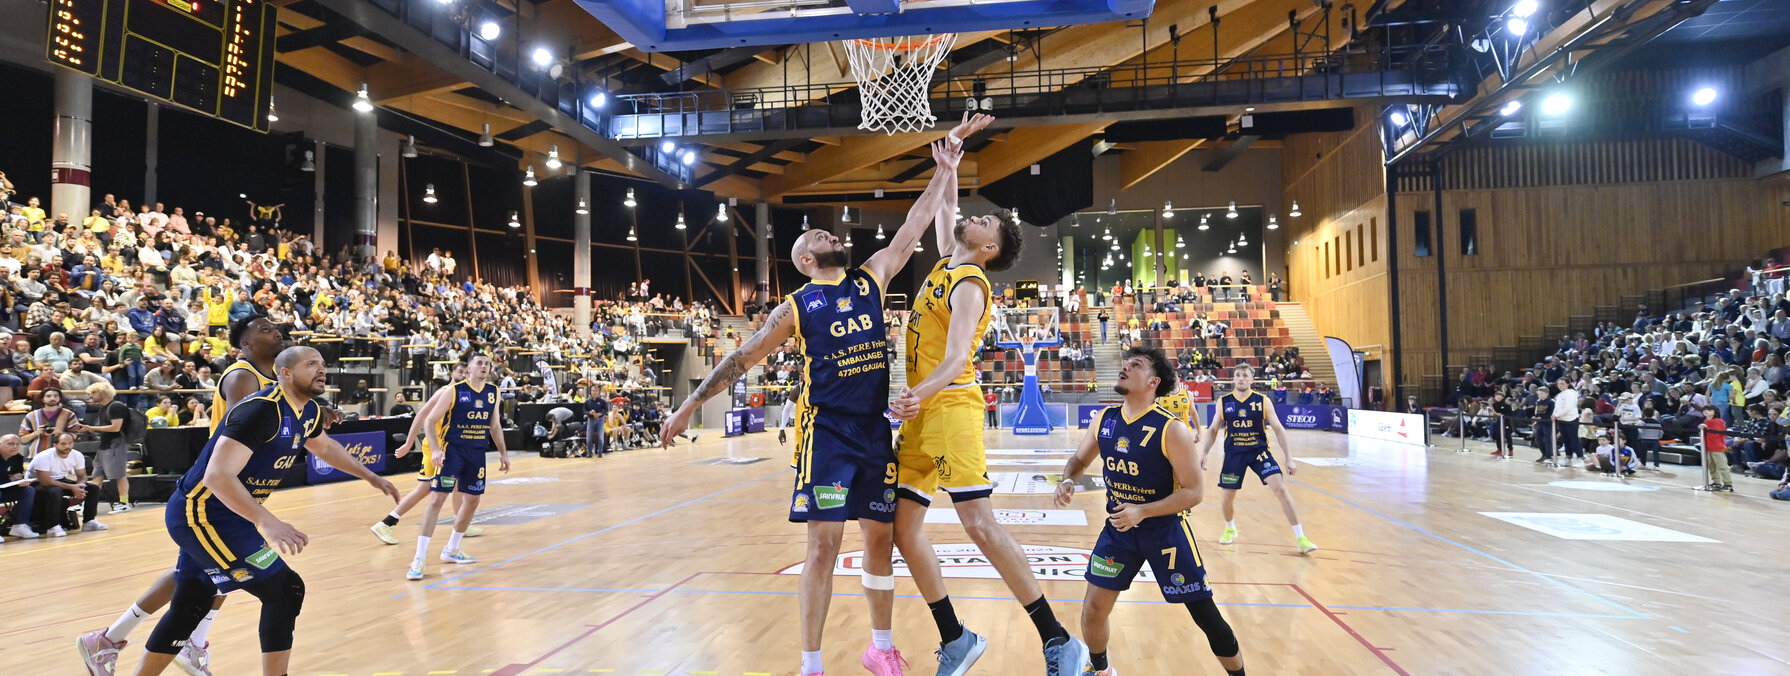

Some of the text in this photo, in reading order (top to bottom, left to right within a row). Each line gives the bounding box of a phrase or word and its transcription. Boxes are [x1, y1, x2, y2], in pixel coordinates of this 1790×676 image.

[853, 277, 870, 296] 9
[806, 299, 823, 311] AXA
[830, 314, 873, 337] GAB
[848, 342, 871, 353] PERE
[837, 351, 884, 367] EMBALLAGES
[838, 366, 861, 378] 47200
[487, 392, 495, 404] 8
[1249, 401, 1263, 411] 11
[467, 411, 489, 420] GAB
[1286, 414, 1316, 424] STECO
[1232, 419, 1253, 428] GAB
[1139, 425, 1157, 447] 7
[359, 445, 373, 457] go
[1256, 451, 1269, 462] 11
[1106, 456, 1139, 476] GAB
[477, 467, 485, 479] 8
[883, 462, 898, 484] 9
[1161, 546, 1177, 570] 7
[1163, 582, 1200, 595] COAXIS
